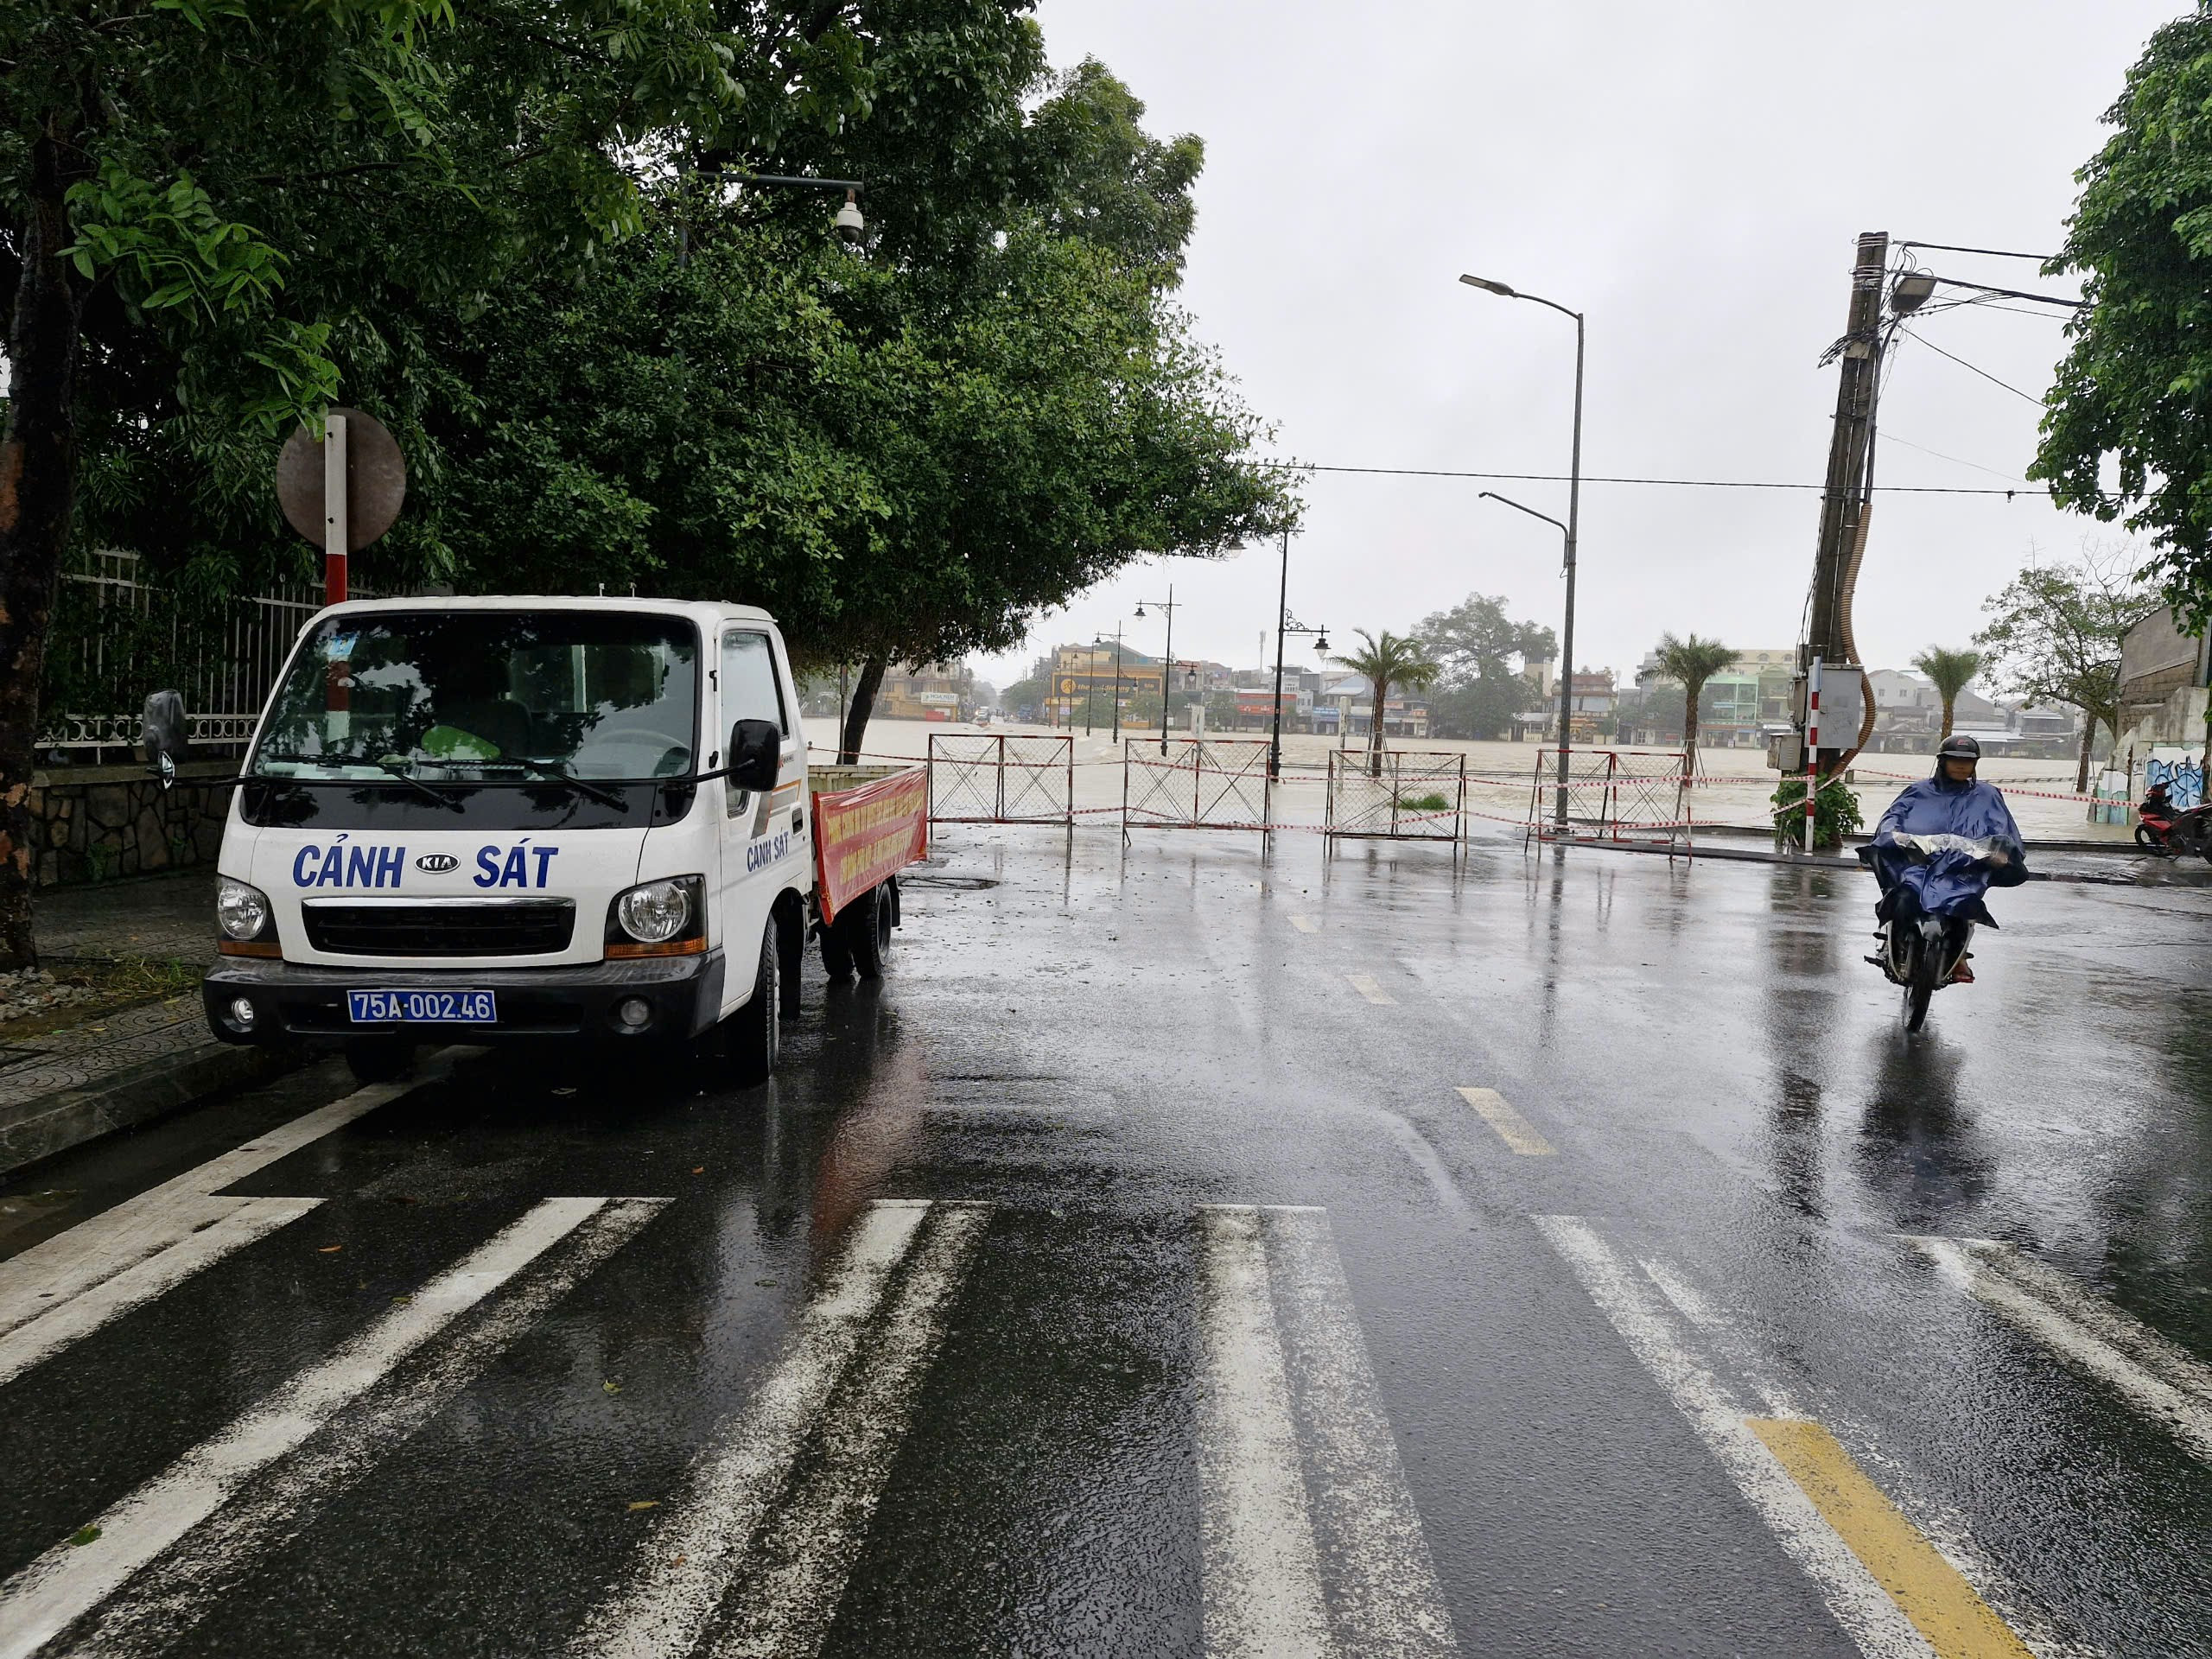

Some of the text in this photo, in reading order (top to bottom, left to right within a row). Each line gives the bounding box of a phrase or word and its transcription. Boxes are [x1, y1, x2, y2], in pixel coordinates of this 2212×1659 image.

[293, 833, 559, 888] CẢNH SÁT
[421, 855, 453, 868] KIA
[747, 827, 789, 873] CẢNH SÁT
[354, 994, 491, 1019] 75A-002.46
